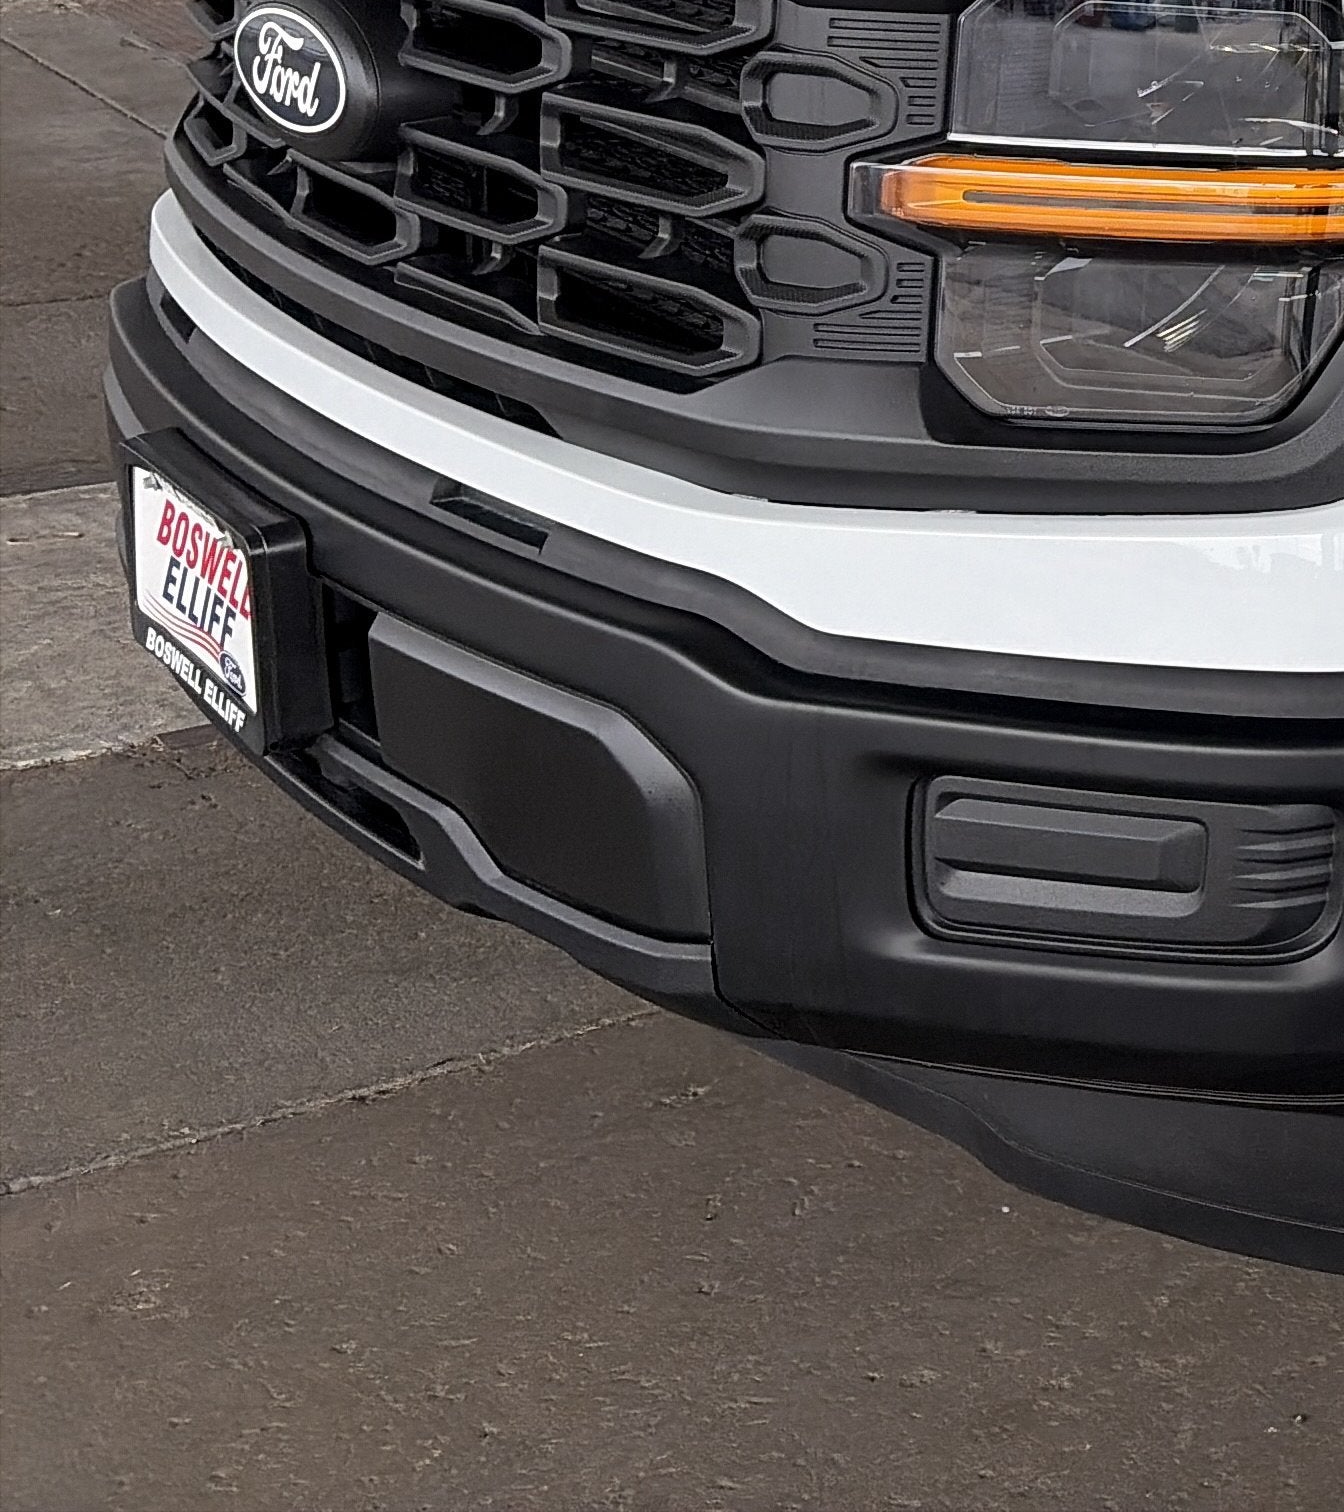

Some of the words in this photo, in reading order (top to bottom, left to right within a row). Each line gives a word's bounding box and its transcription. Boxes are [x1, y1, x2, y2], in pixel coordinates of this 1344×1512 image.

[252, 21, 321, 117] Ford
[156, 498, 253, 621] BOSWELL
[161, 555, 237, 650] ELLIFF
[145, 626, 202, 694] BOSWELL
[203, 677, 247, 733] ELLIFF
[222, 654, 244, 691] Ford
